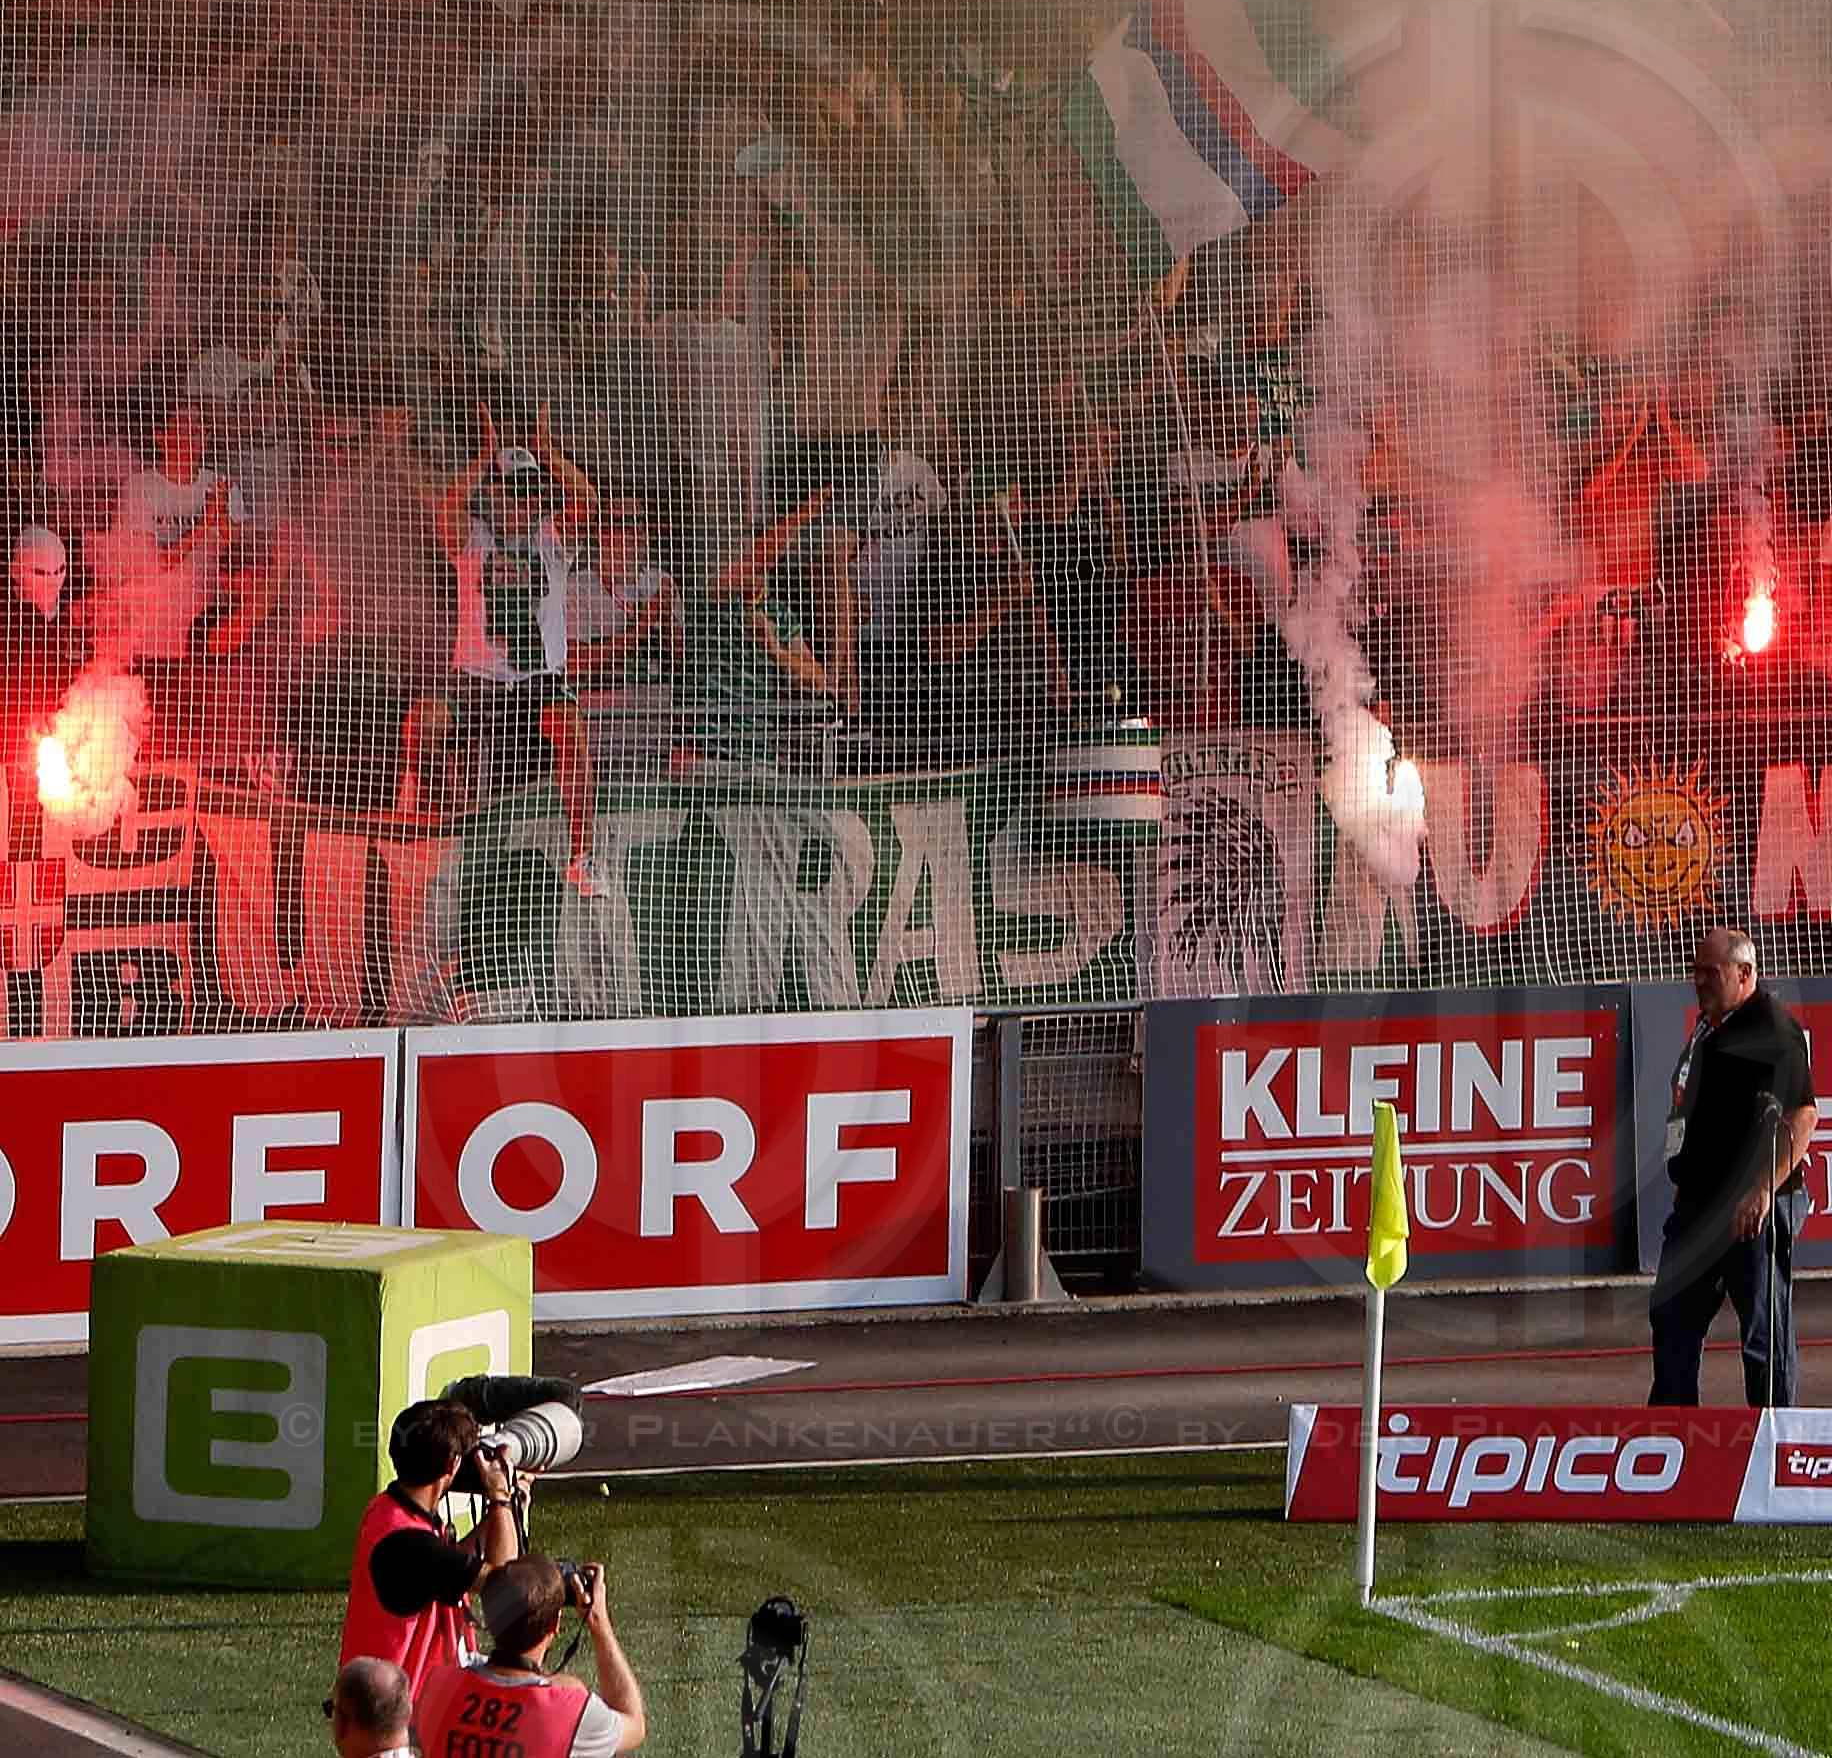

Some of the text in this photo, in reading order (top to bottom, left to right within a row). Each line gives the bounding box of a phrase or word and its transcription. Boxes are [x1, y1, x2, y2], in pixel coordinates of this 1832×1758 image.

[1221, 1036, 1593, 1142] KLEINE
[0, 1110, 343, 1262] RF
[456, 1088, 912, 1243] ORF
[1377, 1413, 1685, 1508] tipico
[459, 1693, 524, 1735] 282
